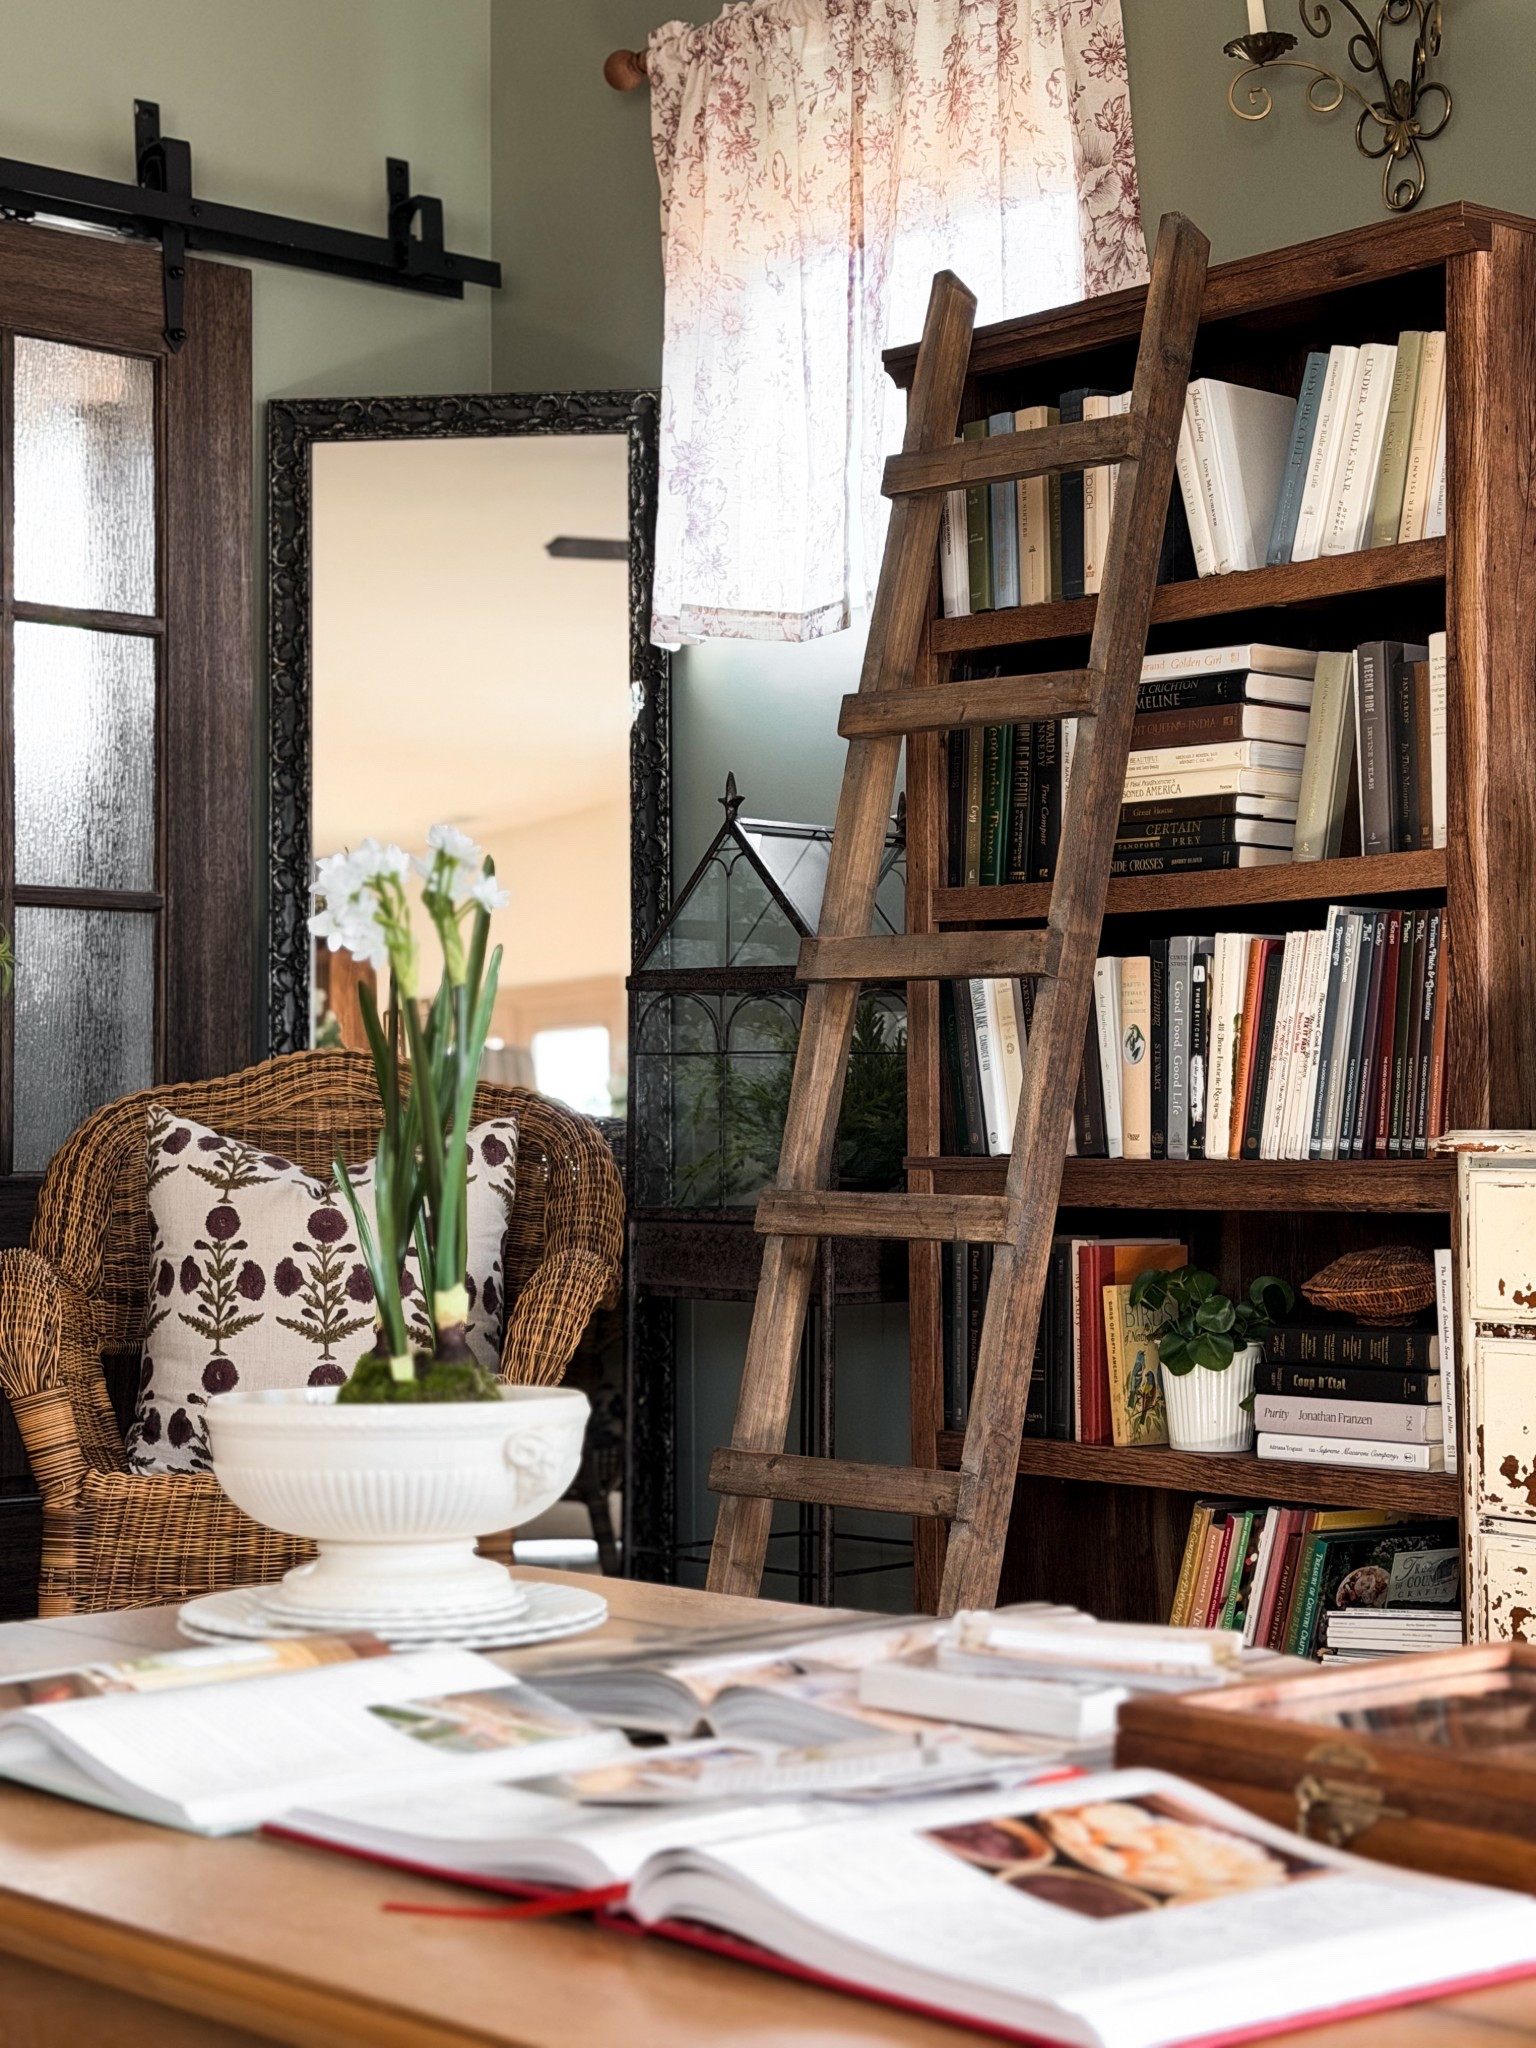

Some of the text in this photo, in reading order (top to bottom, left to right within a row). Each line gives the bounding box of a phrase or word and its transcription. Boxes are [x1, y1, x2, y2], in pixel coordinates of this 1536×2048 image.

[1188, 388, 1200, 417] Johanna
[1292, 362, 1321, 467] JODI PICOULT
[1318, 429, 1327, 447] Ride
[1342, 358, 1374, 492] UNDER A POLE STAR
[1313, 458, 1322, 472] Her
[1316, 448, 1323, 457] of
[1085, 473, 1094, 511] TOUCH
[1180, 457, 1196, 516] EDUCATED
[1206, 479, 1213, 493] ME
[1311, 474, 1319, 489] Life
[1404, 456, 1420, 538] EASTER ISLAND
[1209, 494, 1218, 528] FOREVER
[1171, 654, 1222, 670] Golden Girl
[1148, 680, 1199, 695] CRICHTON
[1364, 664, 1374, 697] DECENT
[1136, 693, 1180, 709] MELINE
[1364, 698, 1375, 713] RIDE
[1132, 725, 1146, 736] DIT
[1147, 722, 1177, 735] QUEEN
[1188, 717, 1217, 731] INDIA
[1015, 746, 1029, 758] OF
[1037, 721, 1045, 767] ENNEDY
[986, 725, 1001, 863] egetarian Times
[1014, 760, 1030, 808] DECEPTION
[1122, 784, 1182, 799] SONED AMERICA
[1402, 770, 1410, 818] Mountain
[1040, 783, 1050, 846] True Compass
[1133, 807, 1174, 817] Great House
[1145, 820, 1202, 836] CERTAIN
[1118, 842, 1160, 850] SANDFORD
[1172, 836, 1201, 847] PREY
[1111, 857, 1164, 873] SIDE CROSSES
[1375, 922, 1385, 946] Candy
[1403, 920, 1411, 943] Pasta
[1415, 919, 1424, 943] Pork
[1342, 956, 1351, 982] Cheese
[1428, 971, 1436, 979] &
[971, 978, 986, 1010] RIMSON
[1021, 977, 1032, 1015] TAKING
[1152, 960, 1164, 1027] Entertaining
[974, 1010, 988, 1031] LAKE
[1312, 992, 1326, 1066] Microwave Cook Book
[979, 1034, 990, 1060] CANDICE
[1172, 980, 1184, 1116] Good Food, Good Life
[1300, 1037, 1308, 1054] FAST
[1215, 1056, 1223, 1087] Favorite
[1236, 1061, 1246, 1099] AMERICAN
[1213, 1088, 1223, 1120] Recipes
[1232, 1100, 1242, 1137] COOKING
[1110, 1322, 1115, 1331] OF
[1125, 1302, 1174, 1328] BIRDS
[970, 1327, 978, 1371] JOHANSEN
[1293, 1374, 1315, 1391] Coup
[1264, 1407, 1373, 1426] Purity Jonathan Franzen
[1317, 1445, 1340, 1456] Supreme
[1341, 1447, 1370, 1457] Macaroni
[1191, 1512, 1201, 1530] The
[1184, 1531, 1198, 1572] Complete
[1192, 1534, 1217, 1630] MARTHA STEWART'S NE
[1295, 1577, 1308, 1613] house
[1398, 1588, 1449, 1598] CRAFTS
[1208, 1600, 1217, 1628] COLLECT
[1270, 1565, 1290, 1640] FAMILY FAVORITES
[1298, 1553, 1323, 1655] TREASURY OF COUNTRY CRAFTS
[1289, 1616, 1299, 1645] style
